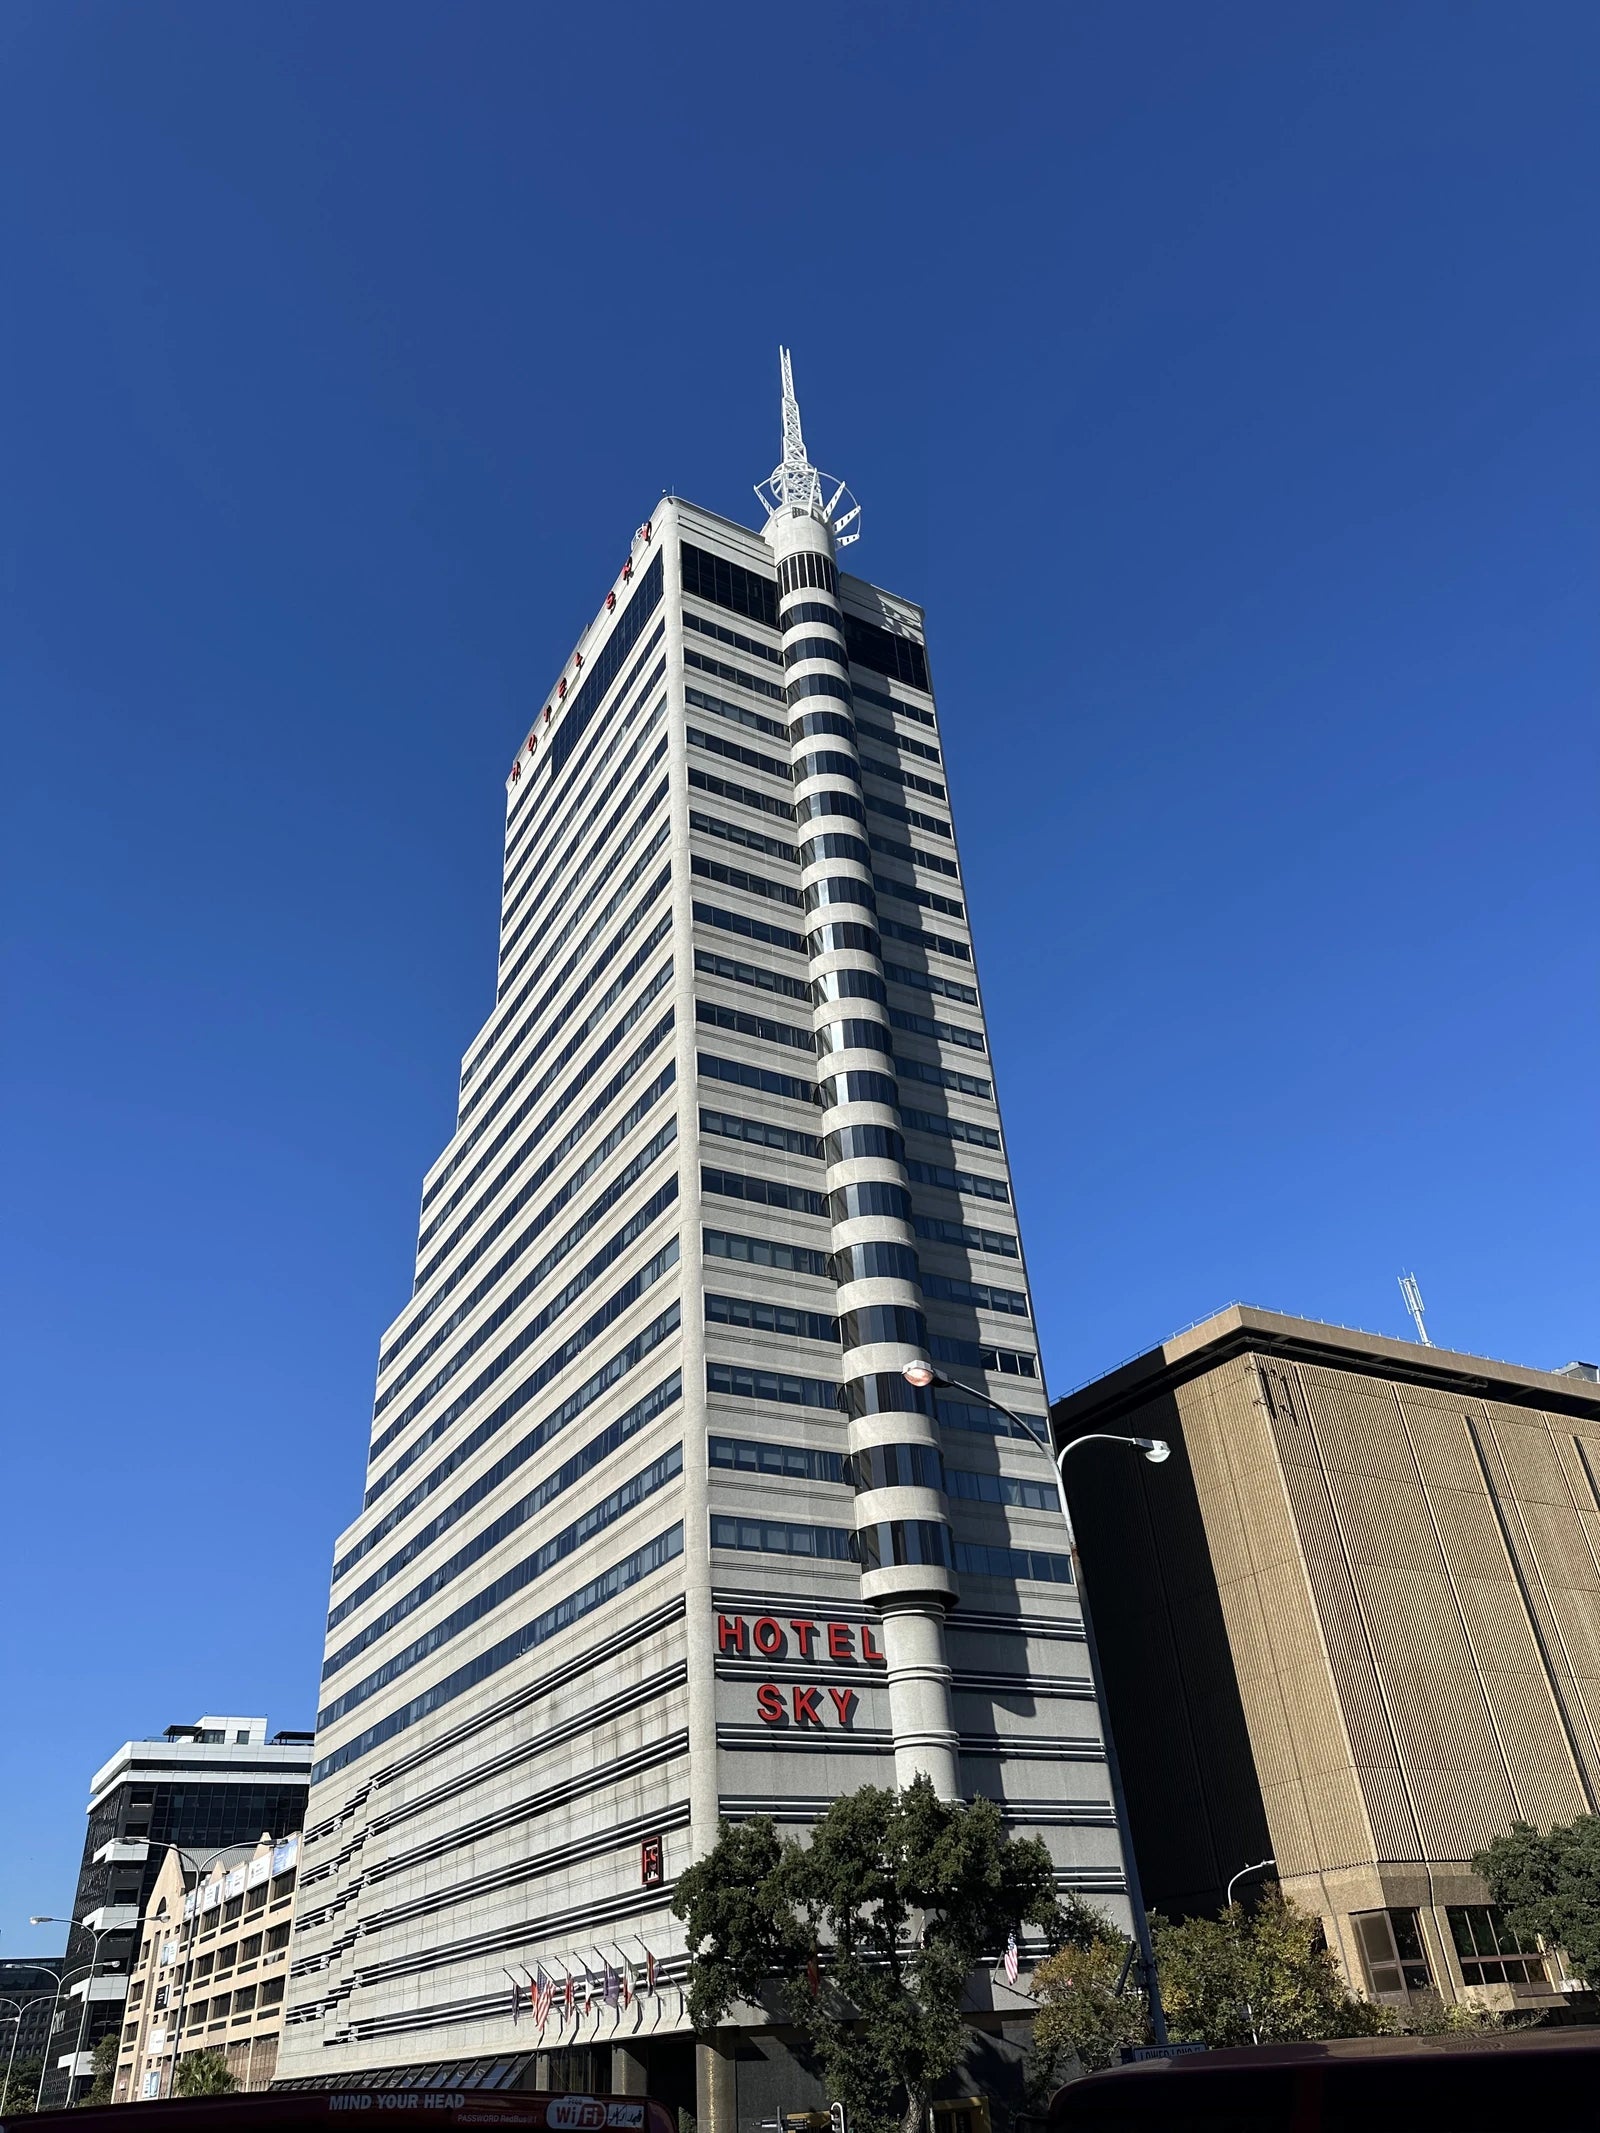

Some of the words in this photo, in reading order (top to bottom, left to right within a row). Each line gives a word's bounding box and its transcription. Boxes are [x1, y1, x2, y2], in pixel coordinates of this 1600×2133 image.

[718, 1615, 883, 1660] HOTEL
[757, 1684, 853, 1723] SKY
[328, 2095, 373, 2110] MIND
[376, 2094, 419, 2109] YOUR
[423, 2094, 466, 2109] HEAD
[457, 2114, 499, 2123] PASSWORD
